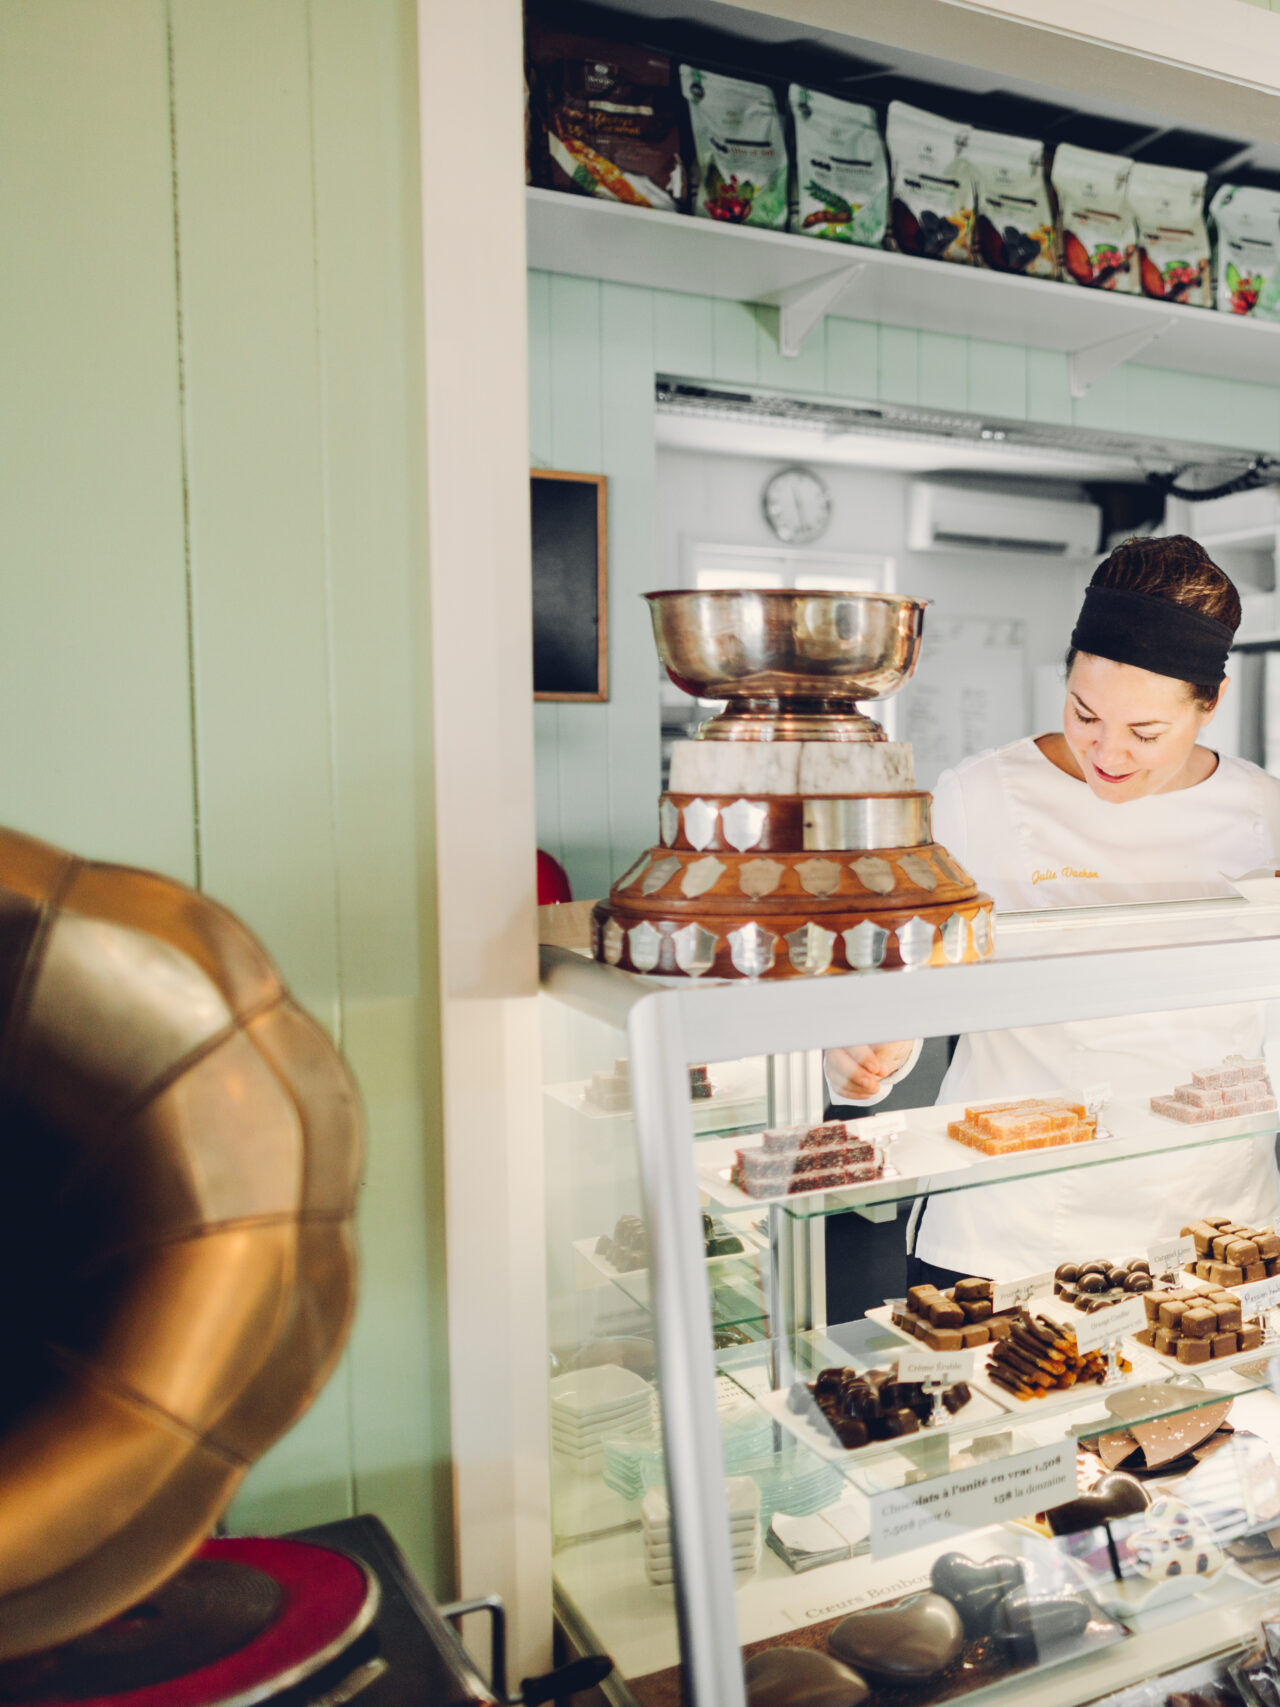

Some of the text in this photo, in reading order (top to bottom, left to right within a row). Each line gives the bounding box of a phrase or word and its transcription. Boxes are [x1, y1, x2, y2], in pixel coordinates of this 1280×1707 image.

[1031, 868, 1057, 885] Julie
[881, 1491, 940, 1518] Chocolats
[942, 1487, 949, 1498] à
[951, 1476, 988, 1496] l'unité
[990, 1473, 1005, 1485] en
[1007, 1466, 1032, 1481] vrac
[1014, 1483, 1024, 1497] la
[1025, 1473, 1067, 1495] douzaine
[944, 1507, 952, 1519] 6
